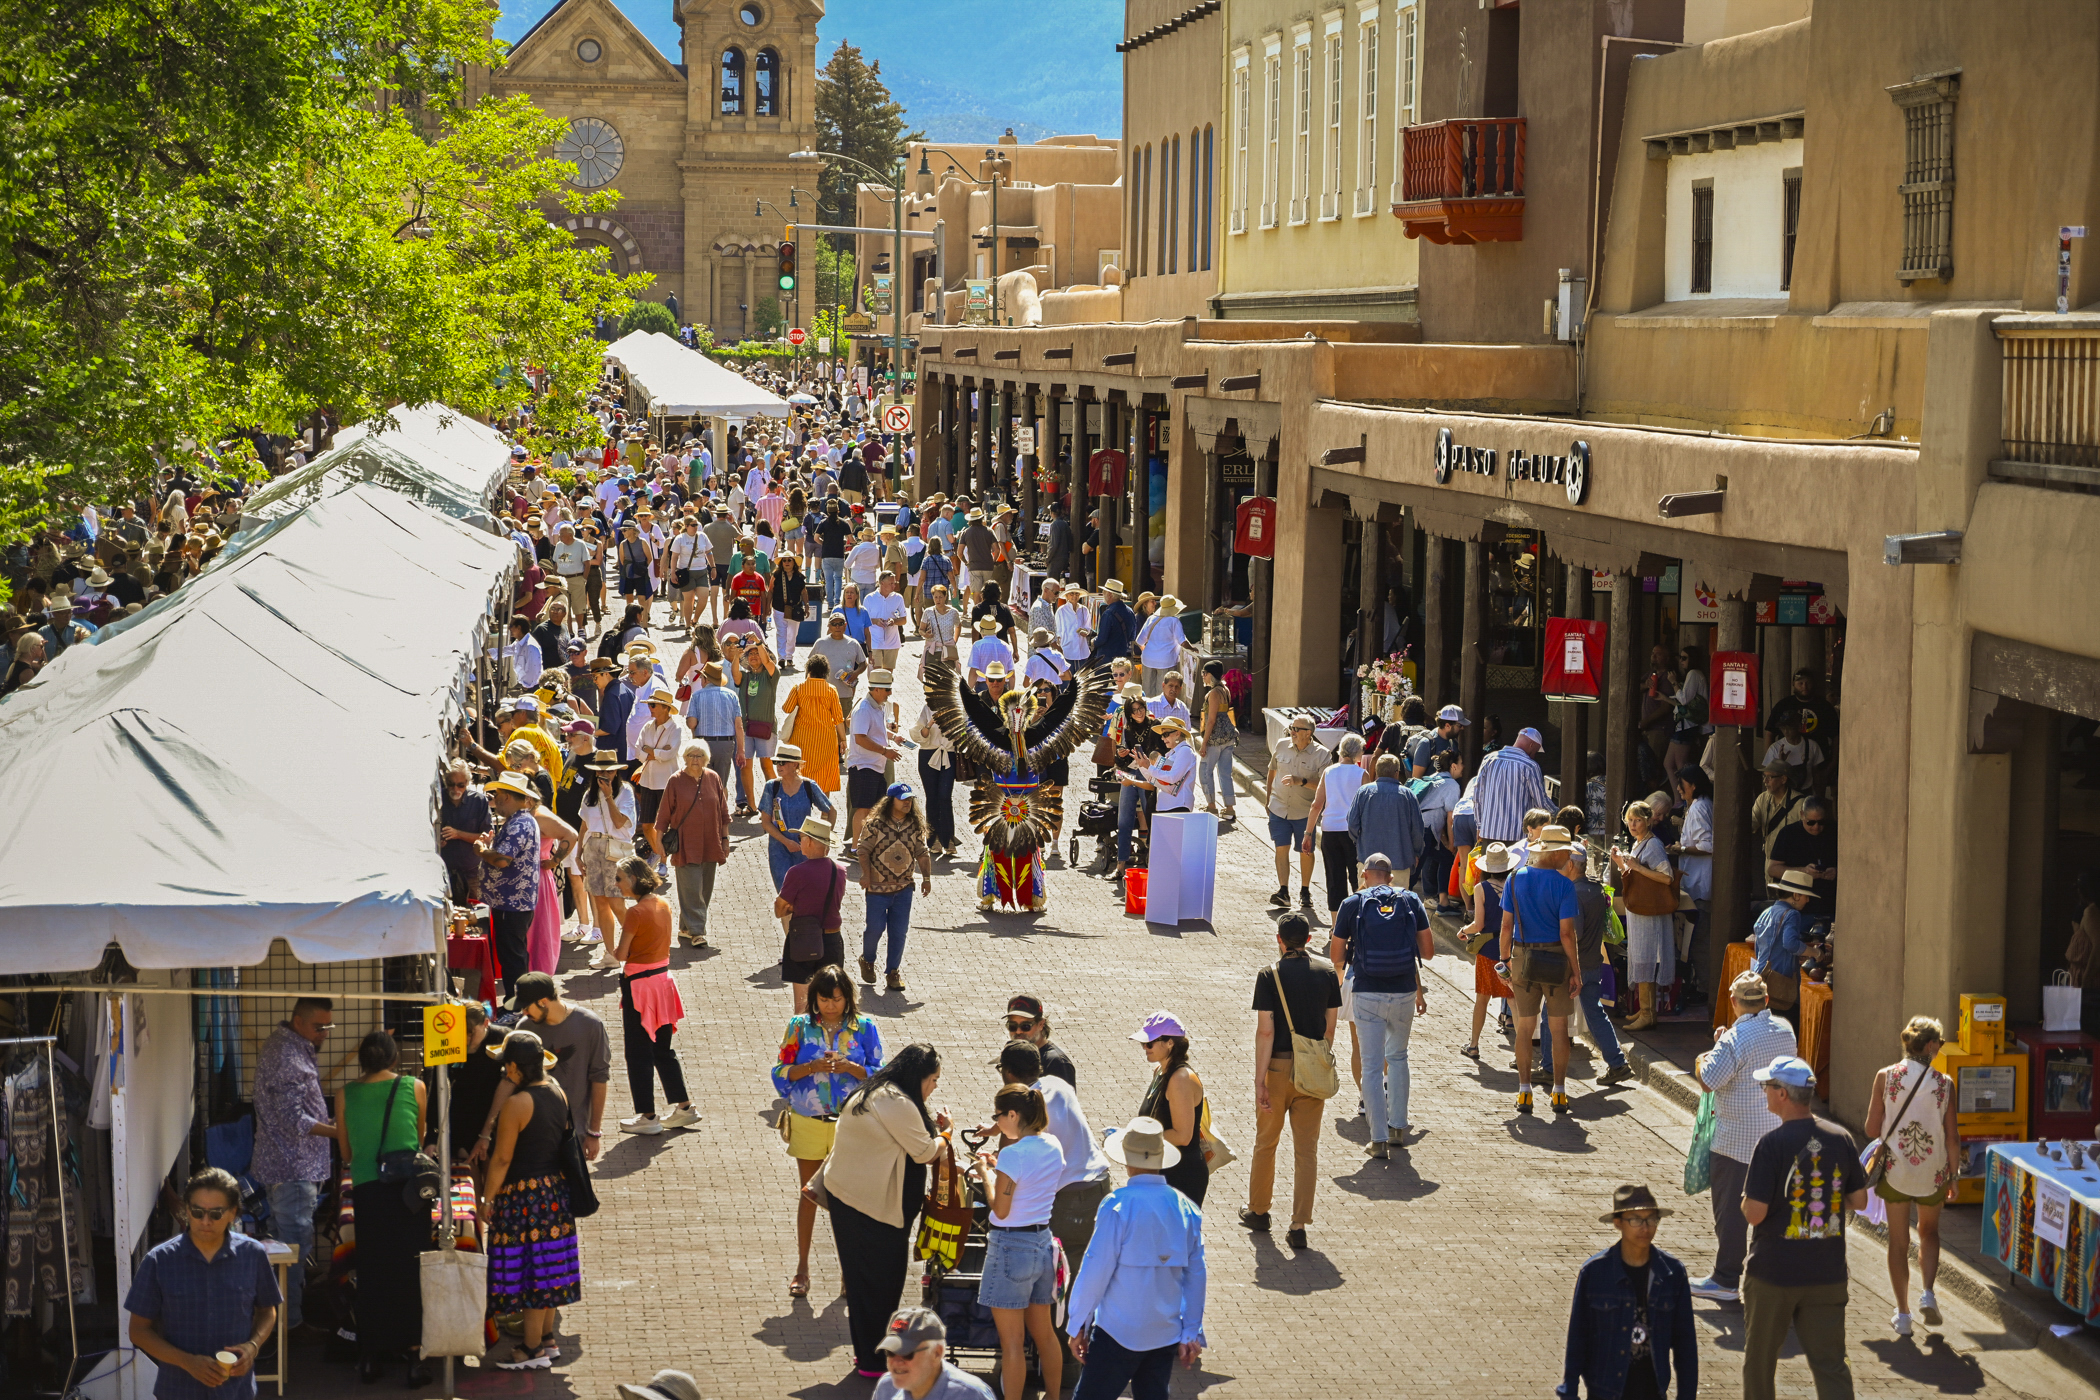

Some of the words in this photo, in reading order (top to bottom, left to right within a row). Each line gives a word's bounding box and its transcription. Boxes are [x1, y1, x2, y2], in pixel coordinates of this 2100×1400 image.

[1451, 445, 1496, 476] PASO
[1510, 449, 1529, 480] de
[1530, 453, 1566, 485] LUZ
[1697, 611, 1719, 619] SHO
[441, 1038, 449, 1047] NO
[430, 1047, 461, 1058] SMOKING
